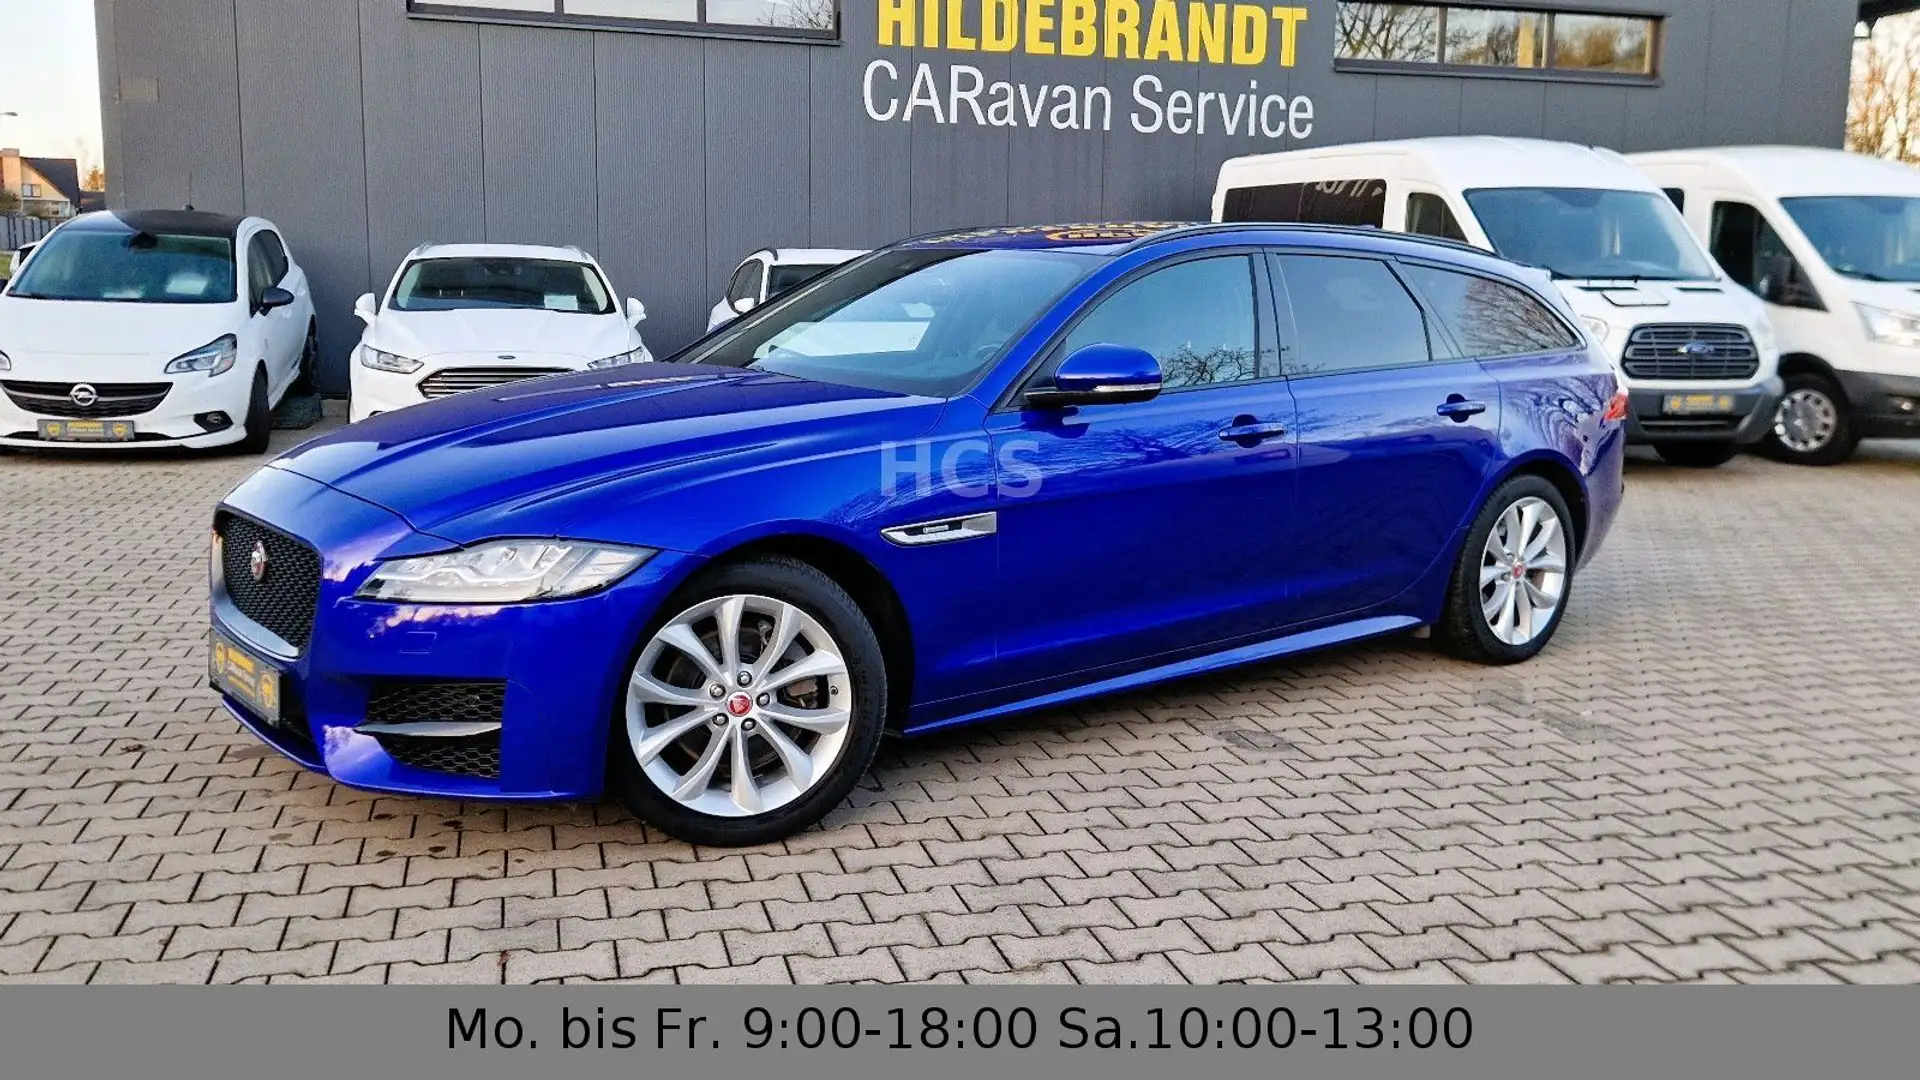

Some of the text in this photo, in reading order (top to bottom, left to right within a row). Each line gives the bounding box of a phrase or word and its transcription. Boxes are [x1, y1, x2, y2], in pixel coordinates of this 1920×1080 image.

[877, 0, 1308, 68] HILDEBRANDT
[862, 58, 1315, 140] CARavan Service
